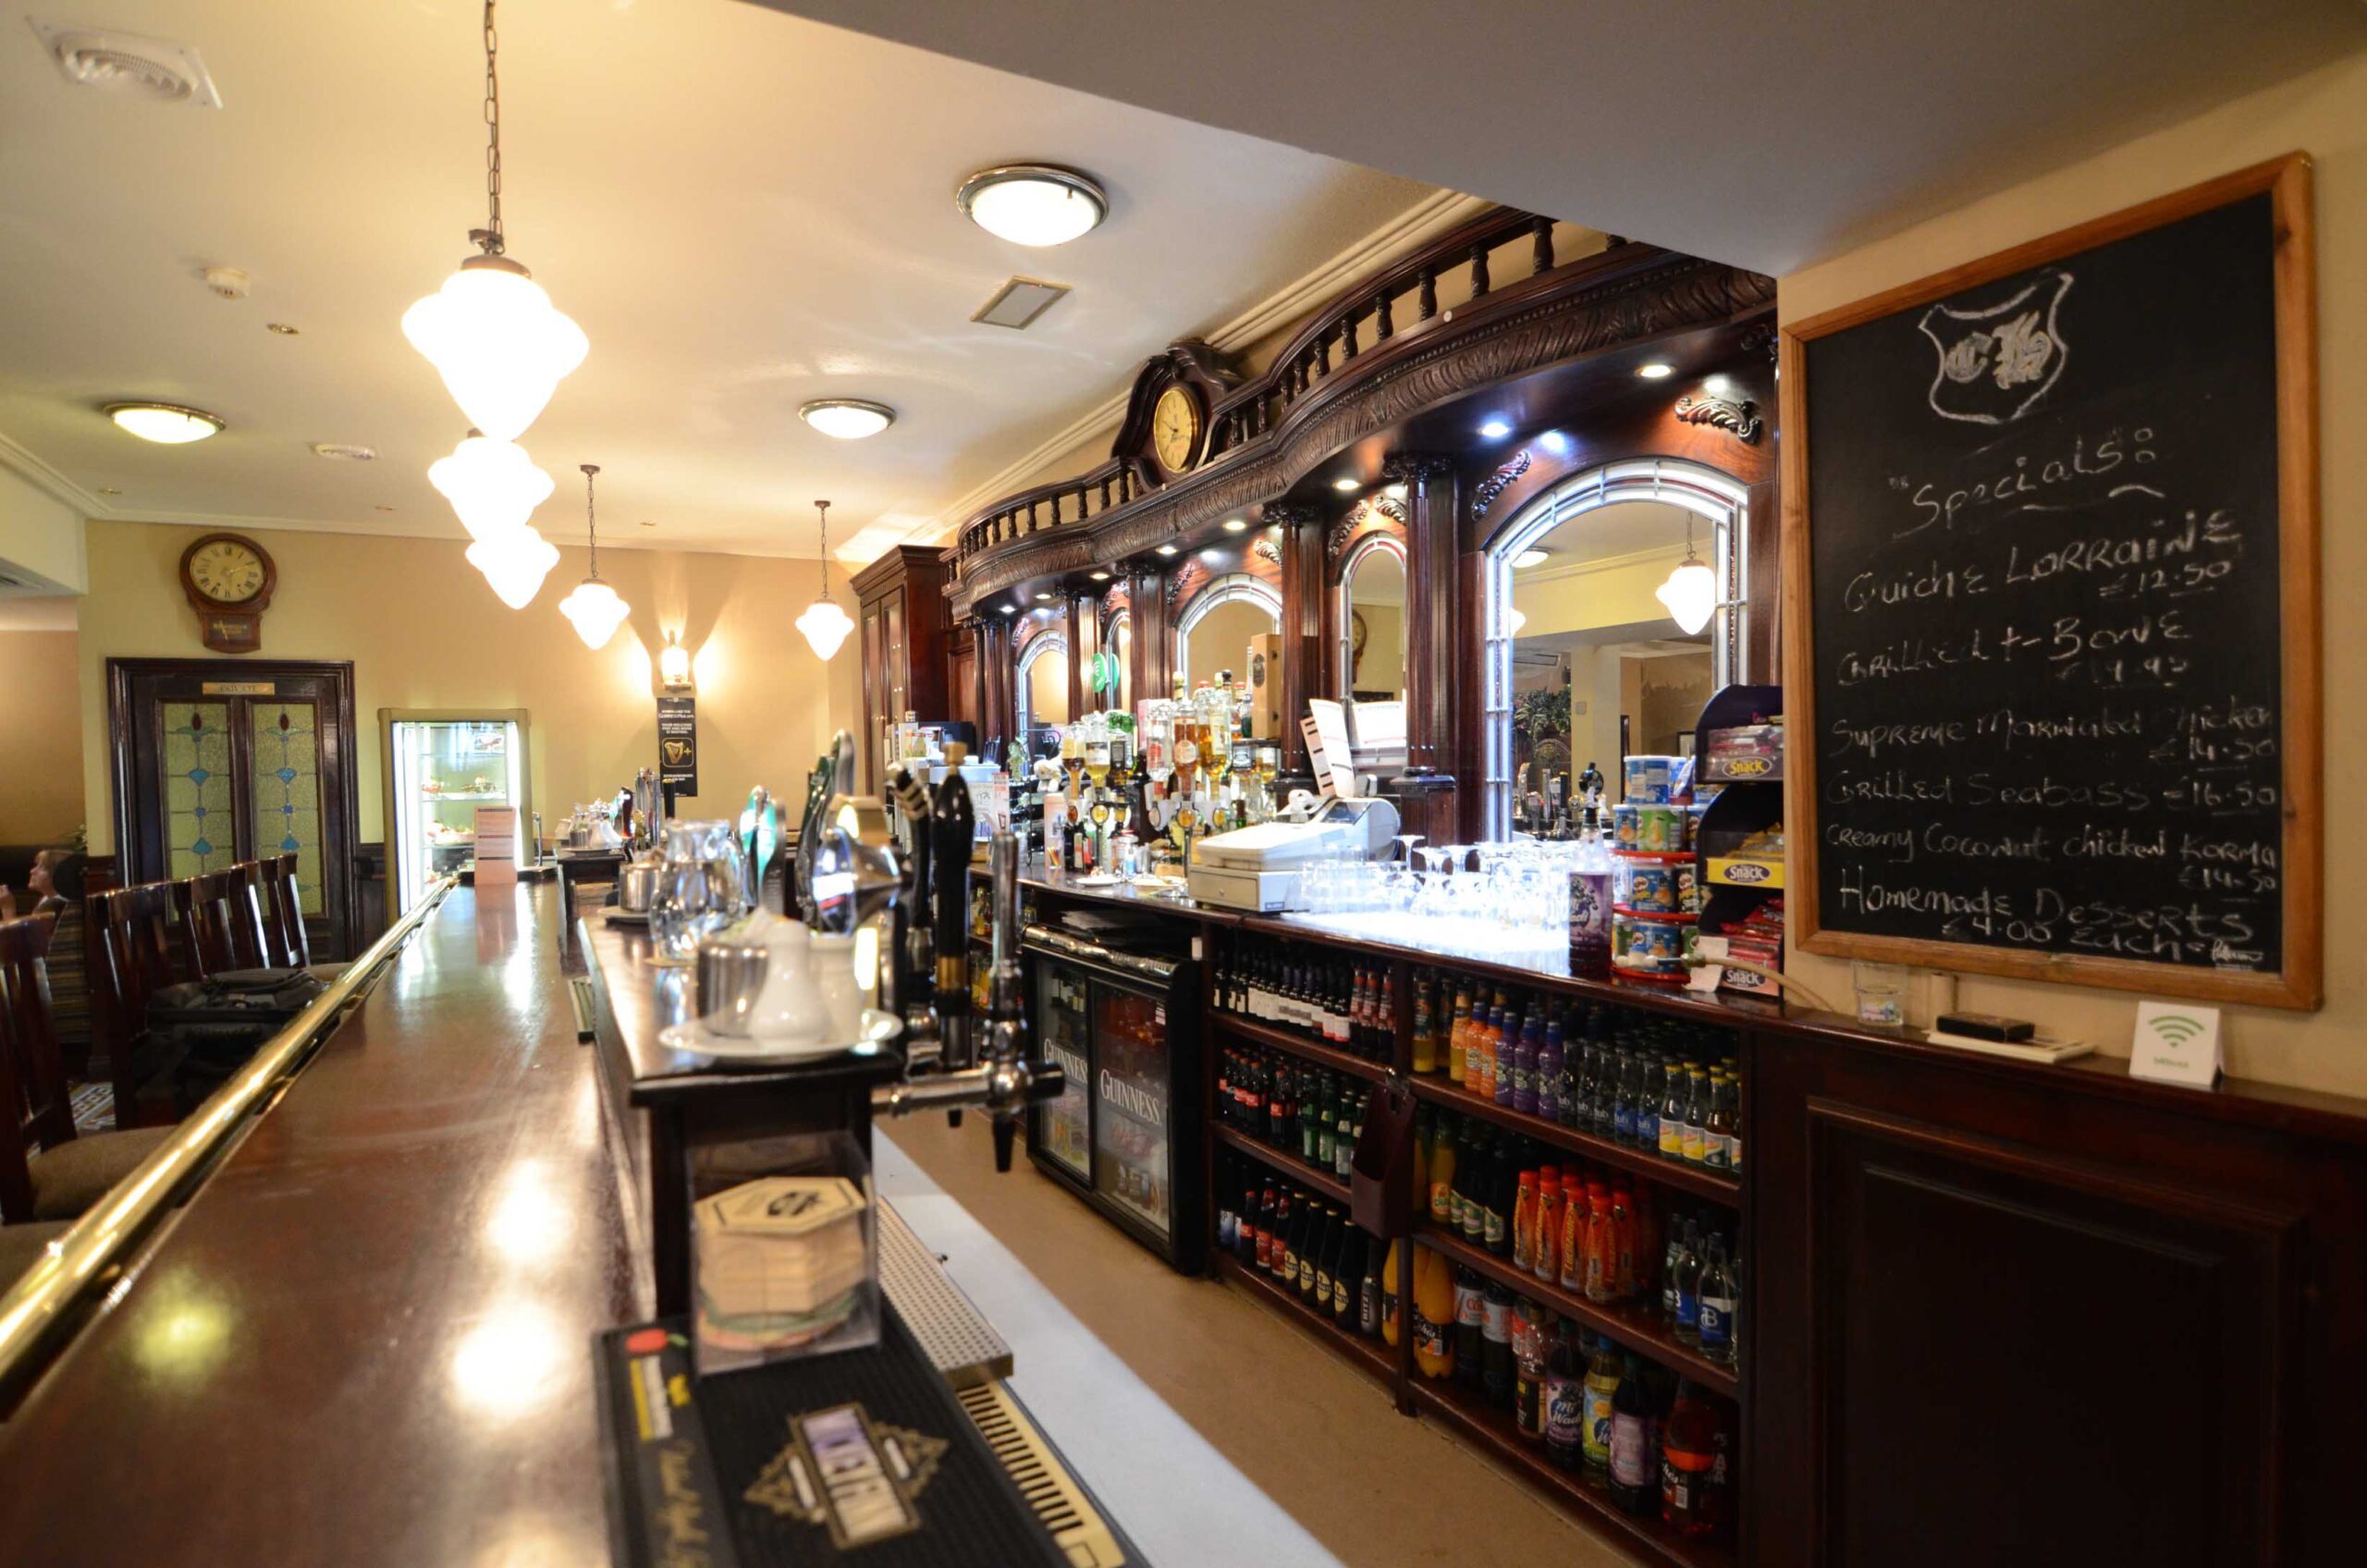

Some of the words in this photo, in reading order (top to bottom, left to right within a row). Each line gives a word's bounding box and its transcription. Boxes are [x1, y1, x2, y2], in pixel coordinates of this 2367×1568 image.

[1729, 758, 1767, 776] Snack
[1729, 864, 1768, 880] Snack
[1726, 968, 1761, 987] Snack
[1044, 1037, 1088, 1084] GUINNES
[1100, 1069, 1160, 1125] GUINNESS
